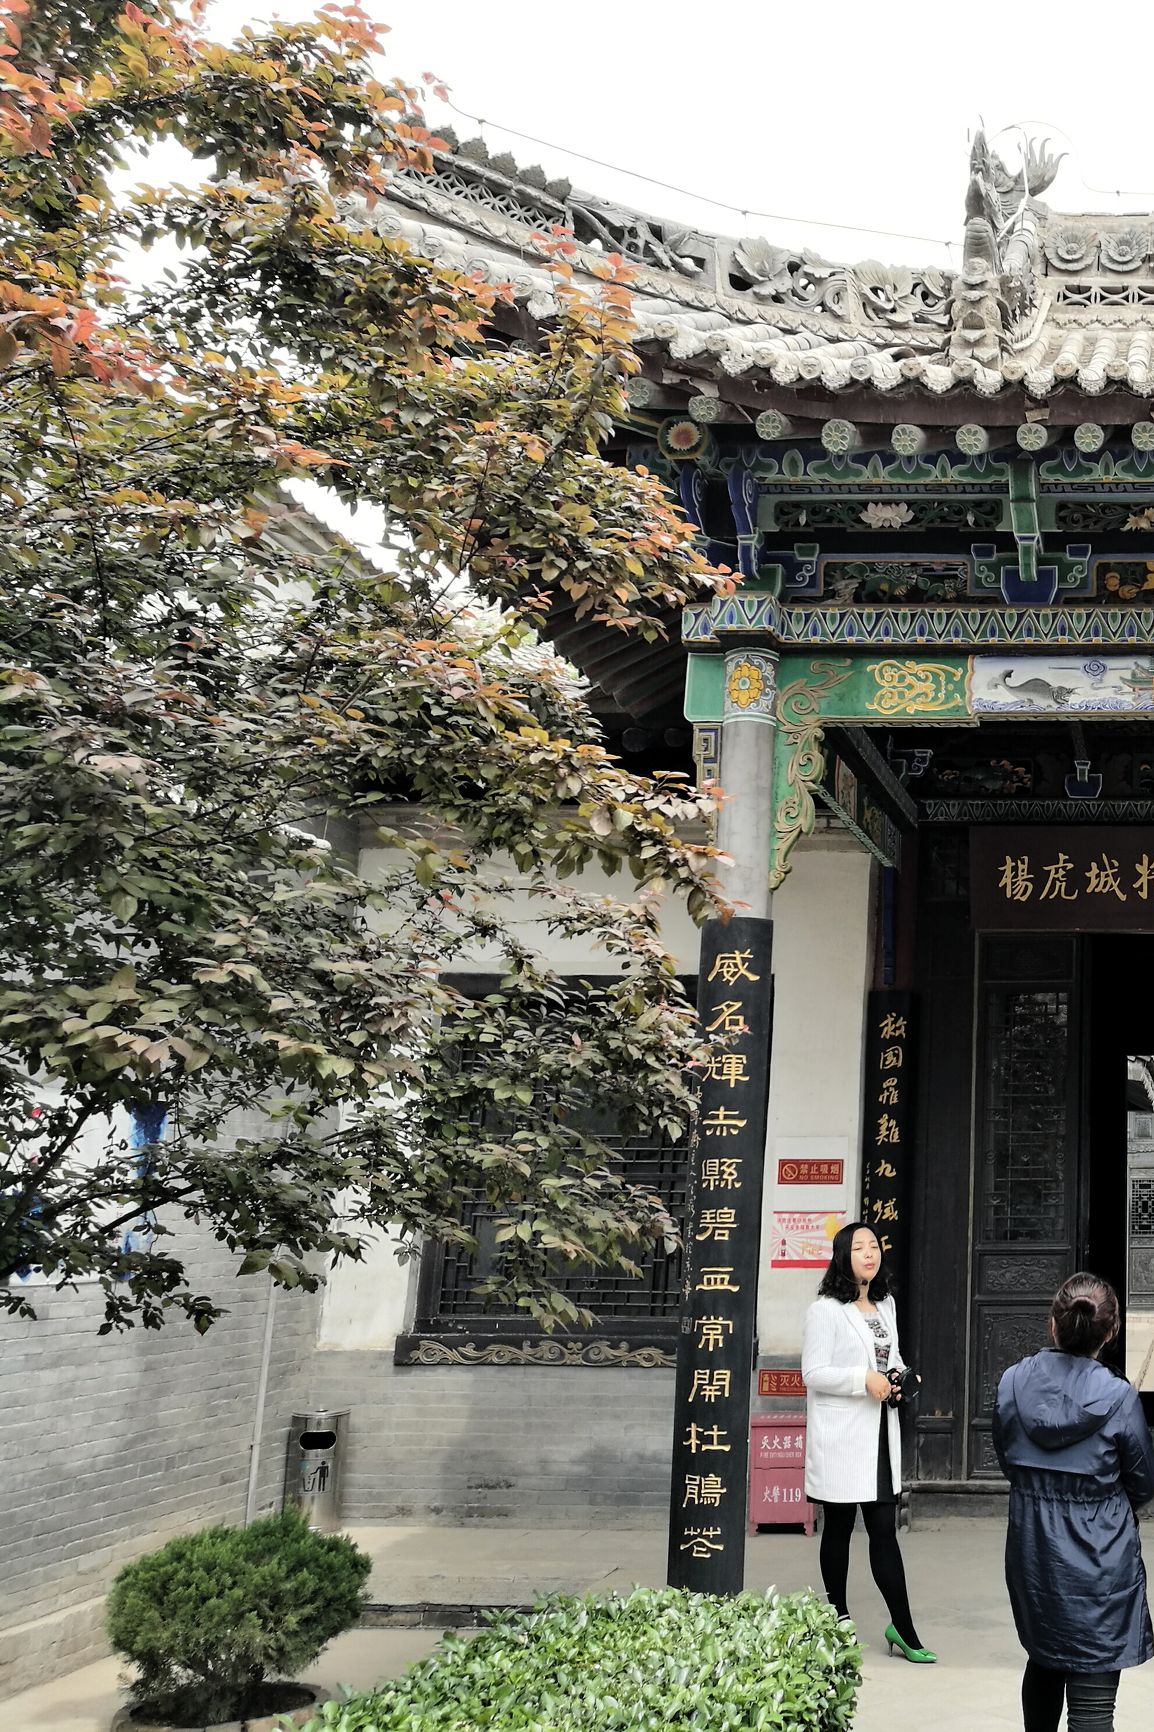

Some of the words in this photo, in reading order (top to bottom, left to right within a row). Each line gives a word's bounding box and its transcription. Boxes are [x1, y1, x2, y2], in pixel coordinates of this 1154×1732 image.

[800, 1164, 840, 1175] 禁止吸烟
[780, 1374, 806, 1386] 灭火
[760, 1434, 804, 1449] 灭火器箱
